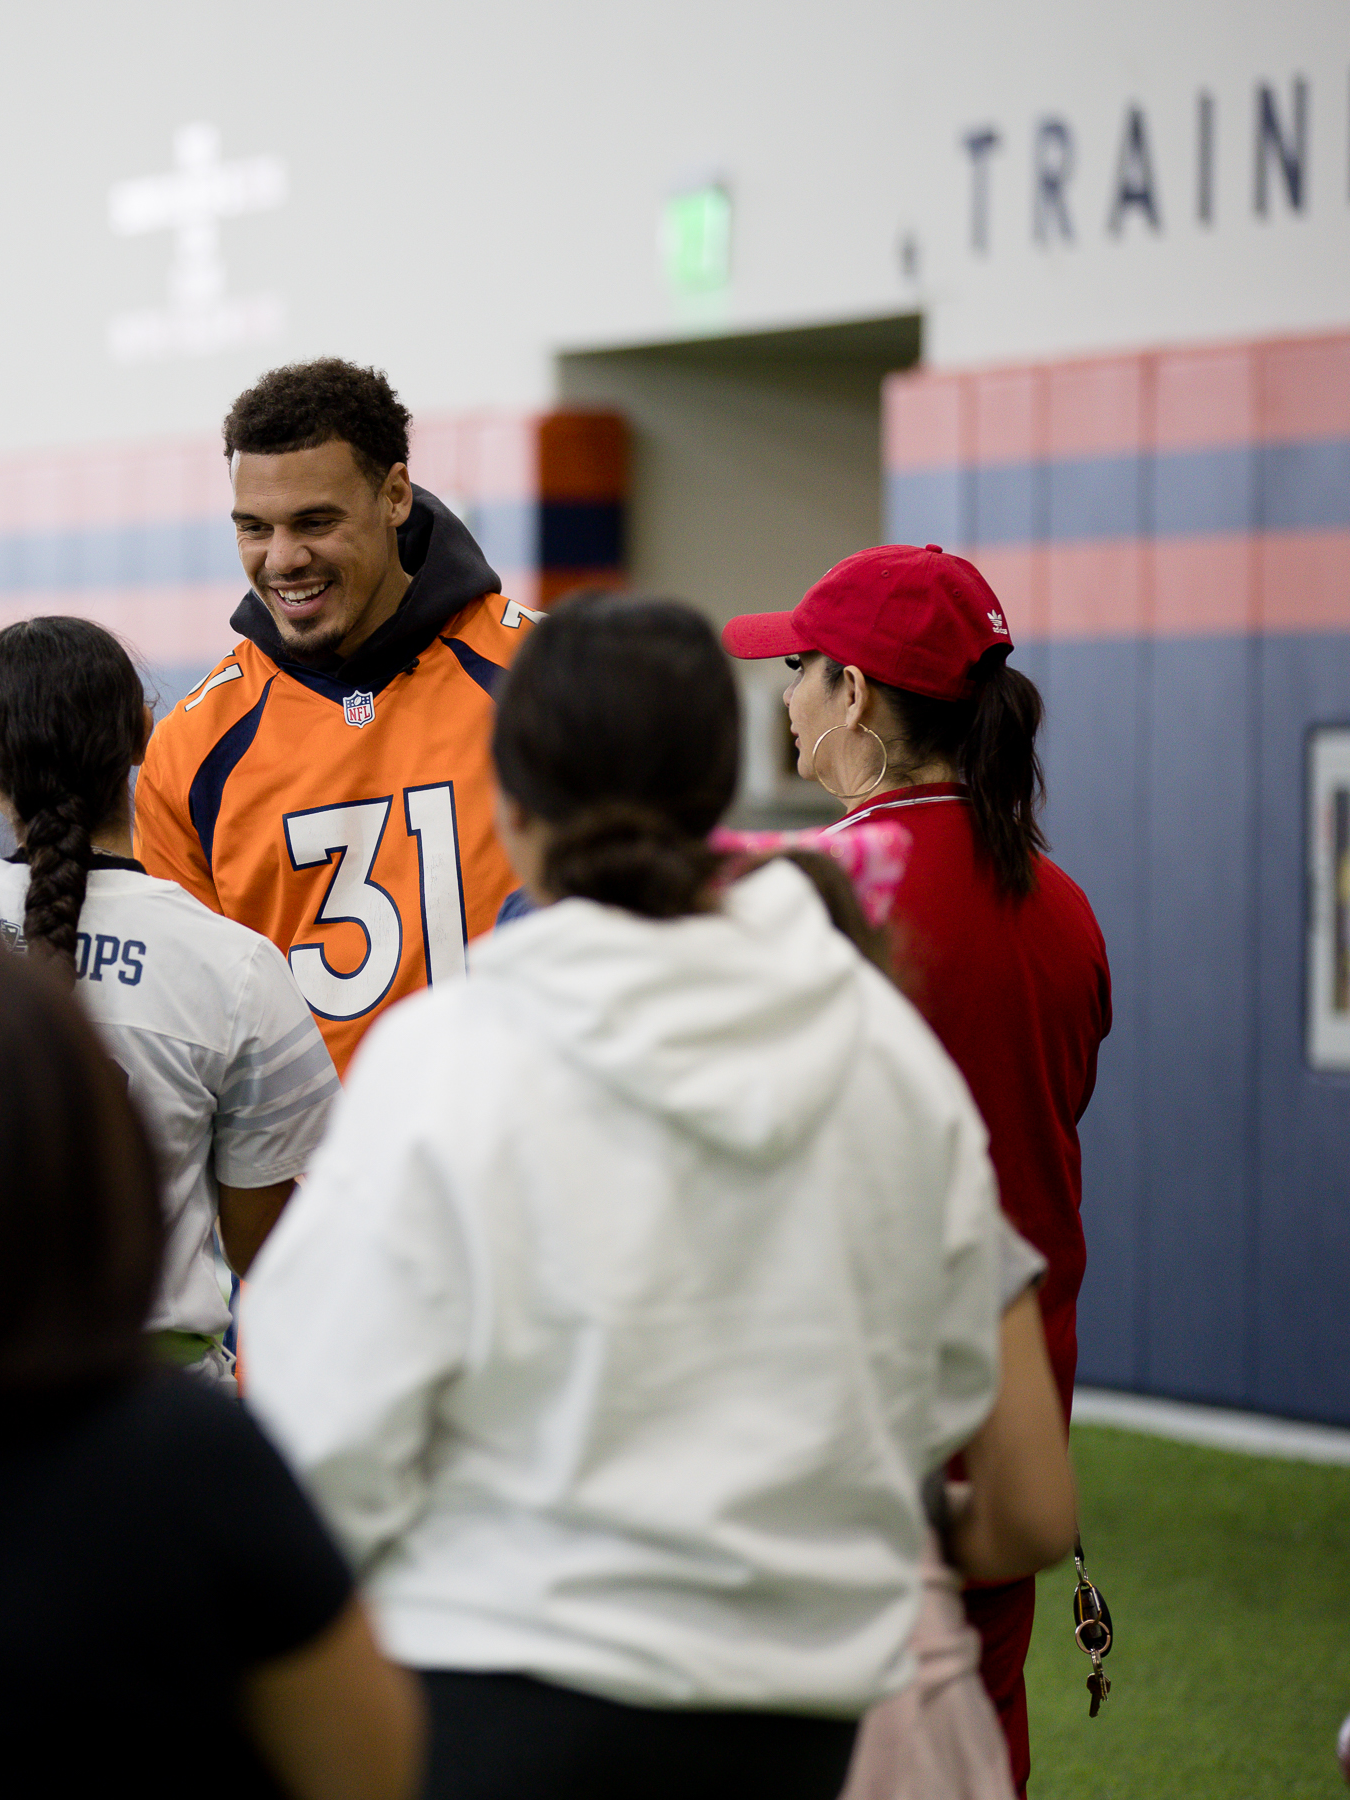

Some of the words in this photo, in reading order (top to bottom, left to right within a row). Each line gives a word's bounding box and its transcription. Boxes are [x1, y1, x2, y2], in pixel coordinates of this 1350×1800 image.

[961, 70, 1350, 256] TRAIN
[348, 705, 371, 722] NFL
[282, 780, 470, 1022] 31
